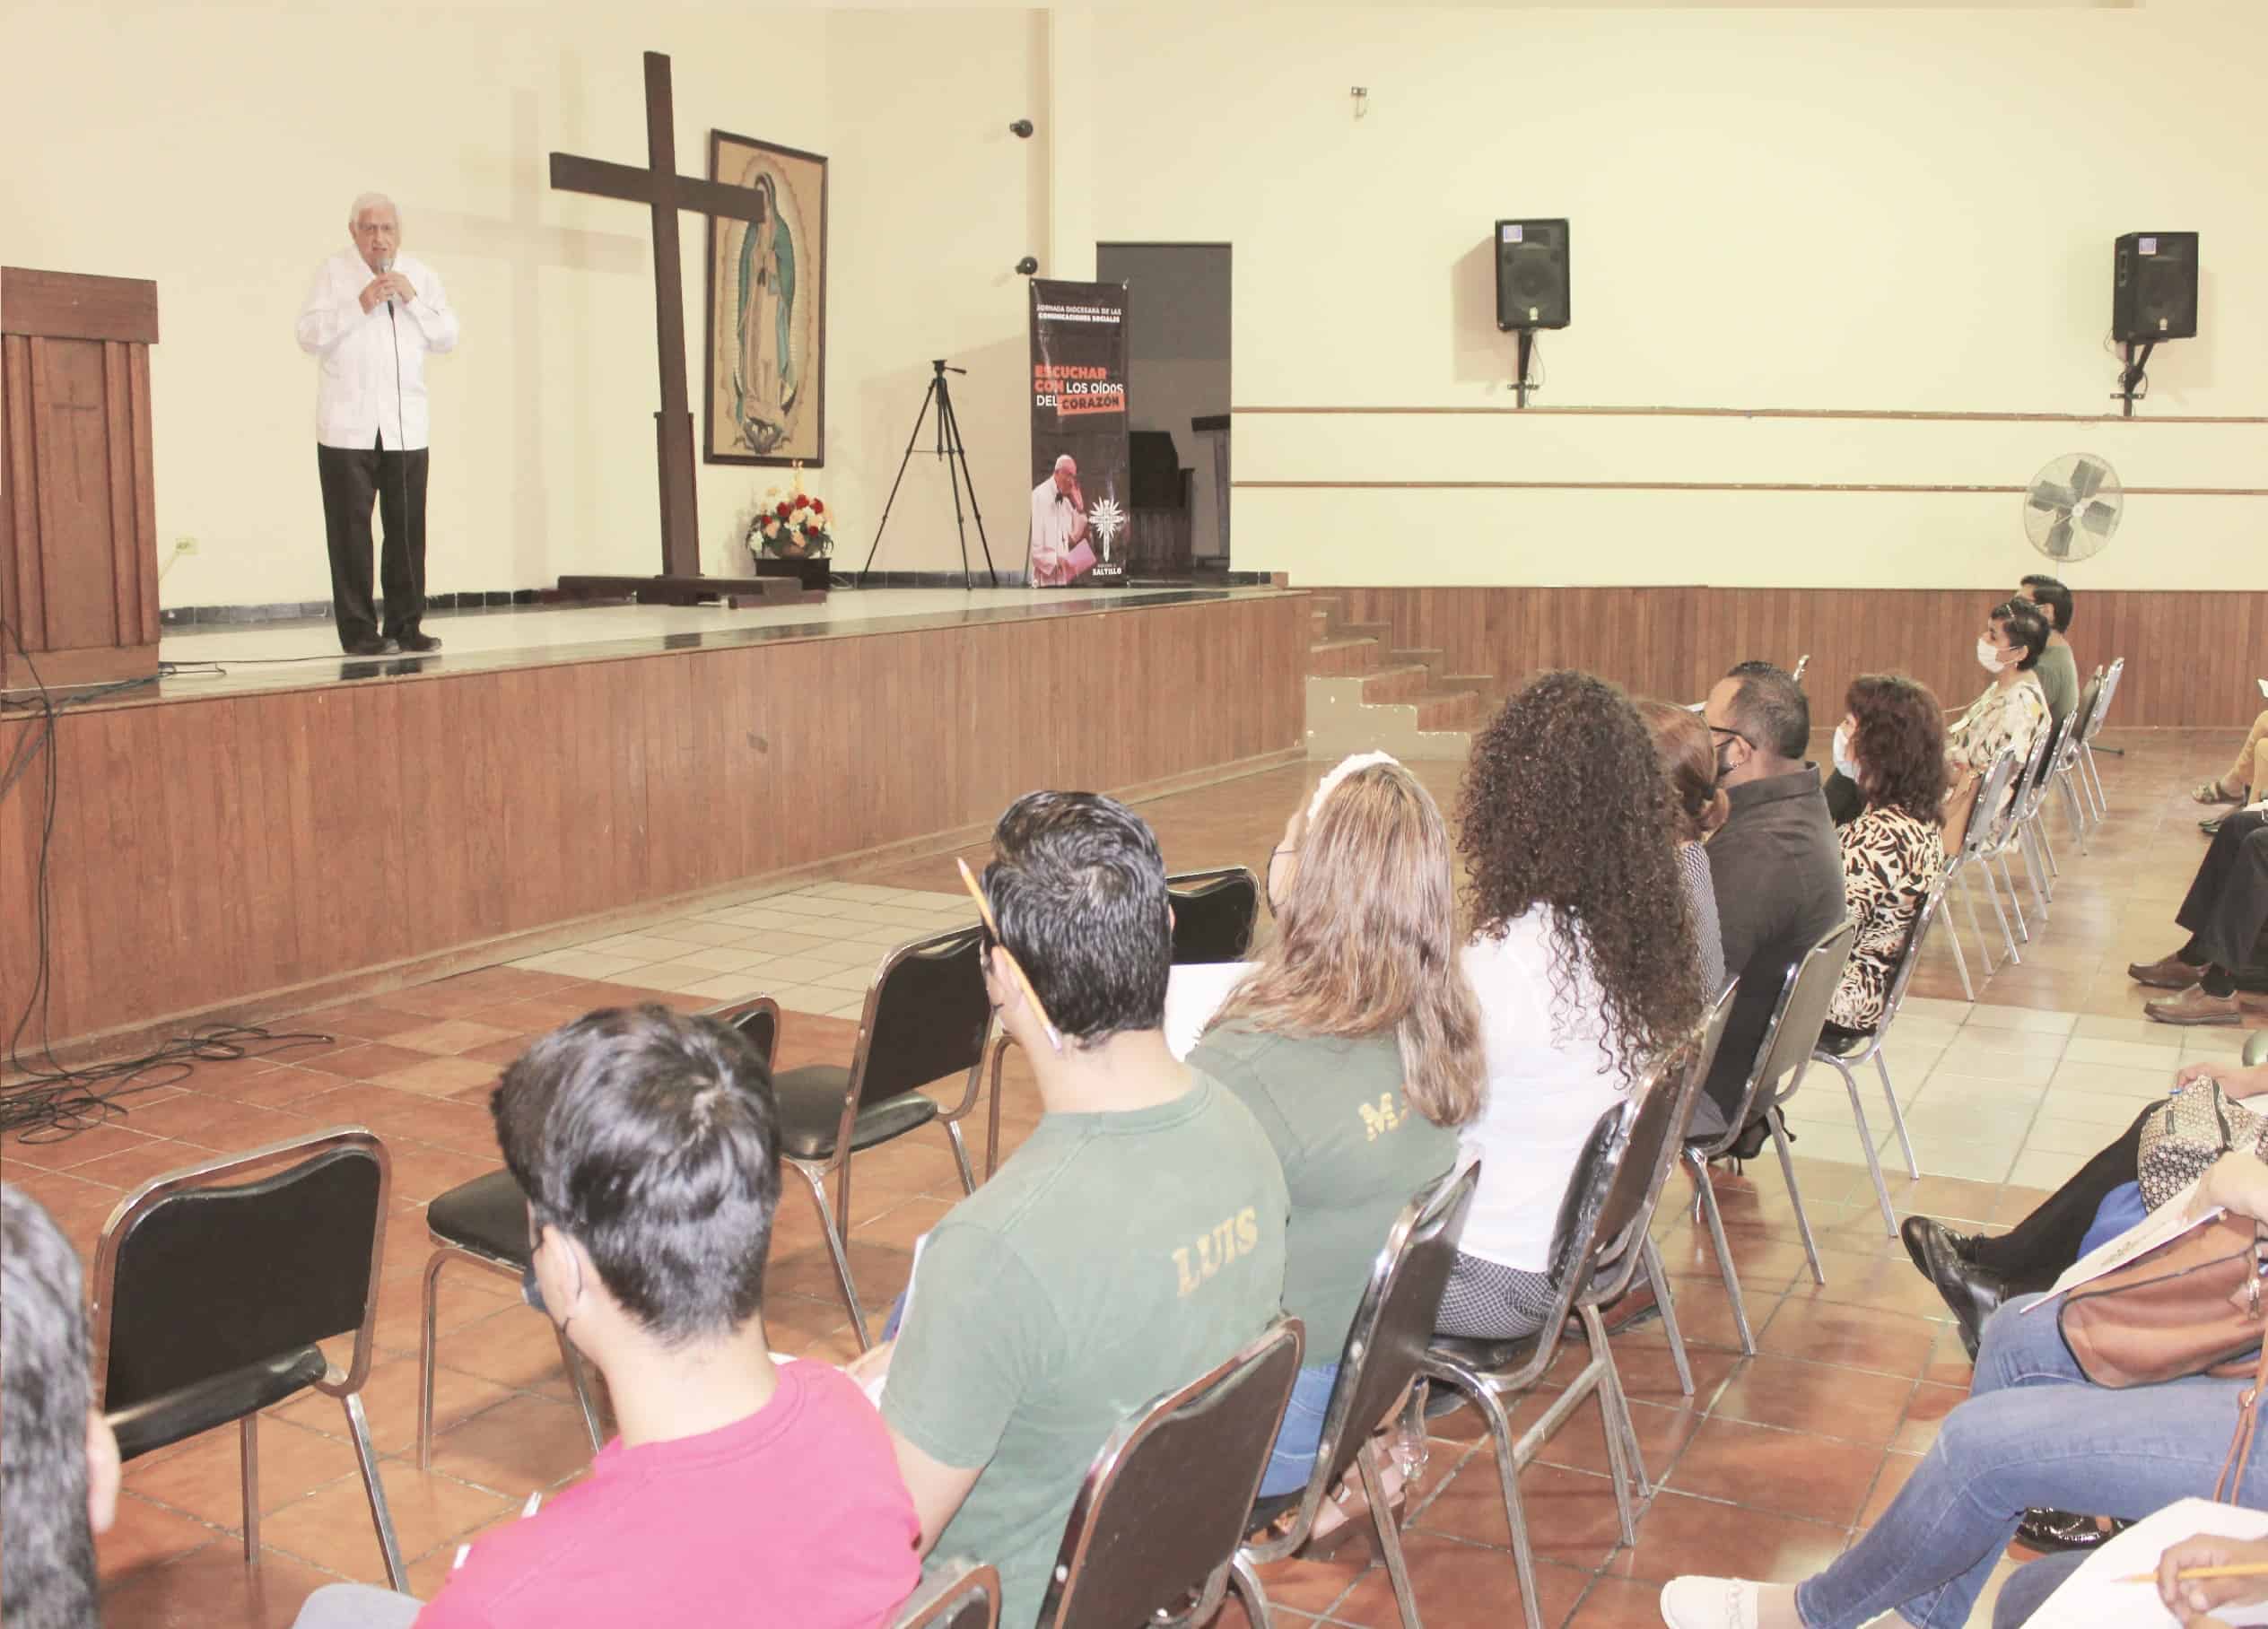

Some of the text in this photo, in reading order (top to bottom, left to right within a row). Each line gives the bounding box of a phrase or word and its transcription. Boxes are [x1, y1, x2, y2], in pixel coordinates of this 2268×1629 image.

[1036, 304, 1064, 312] JORNADA
[1034, 365, 1107, 379] ESCUCHAR
[1034, 379, 1124, 394] CON LOS OÍDOS
[1036, 395, 1120, 410] DEL CORAZÓN
[1172, 1206, 1259, 1298] LUIS
